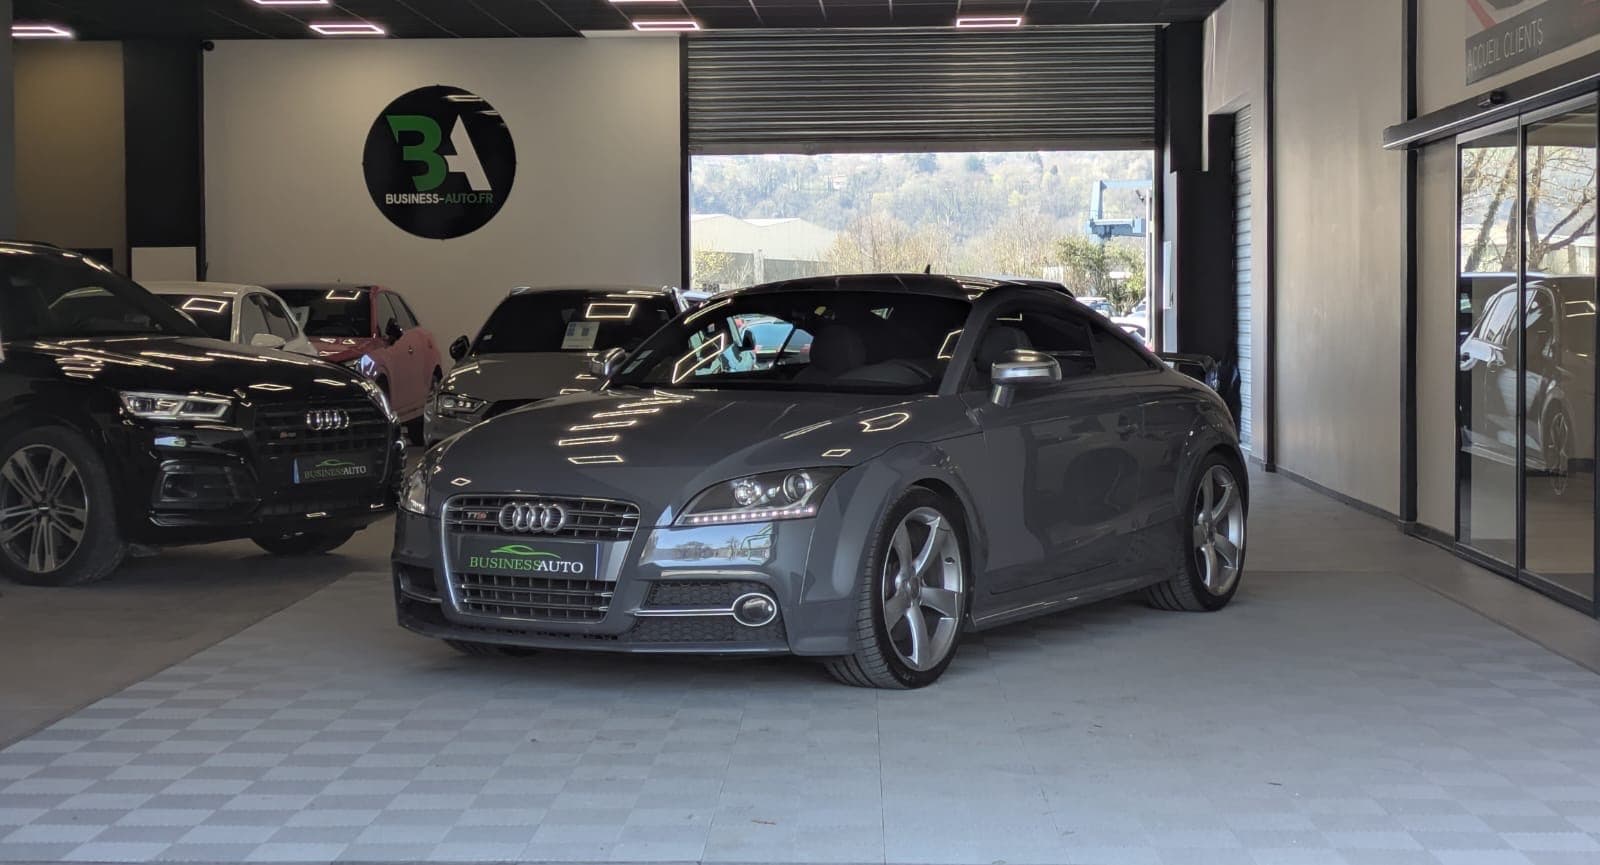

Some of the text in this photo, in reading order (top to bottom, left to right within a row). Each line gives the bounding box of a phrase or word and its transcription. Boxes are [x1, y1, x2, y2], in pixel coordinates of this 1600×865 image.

[1467, 18, 1544, 74] ACCUEIL CLIENTS
[385, 193, 494, 205] BUSINESS-AUTO.FR
